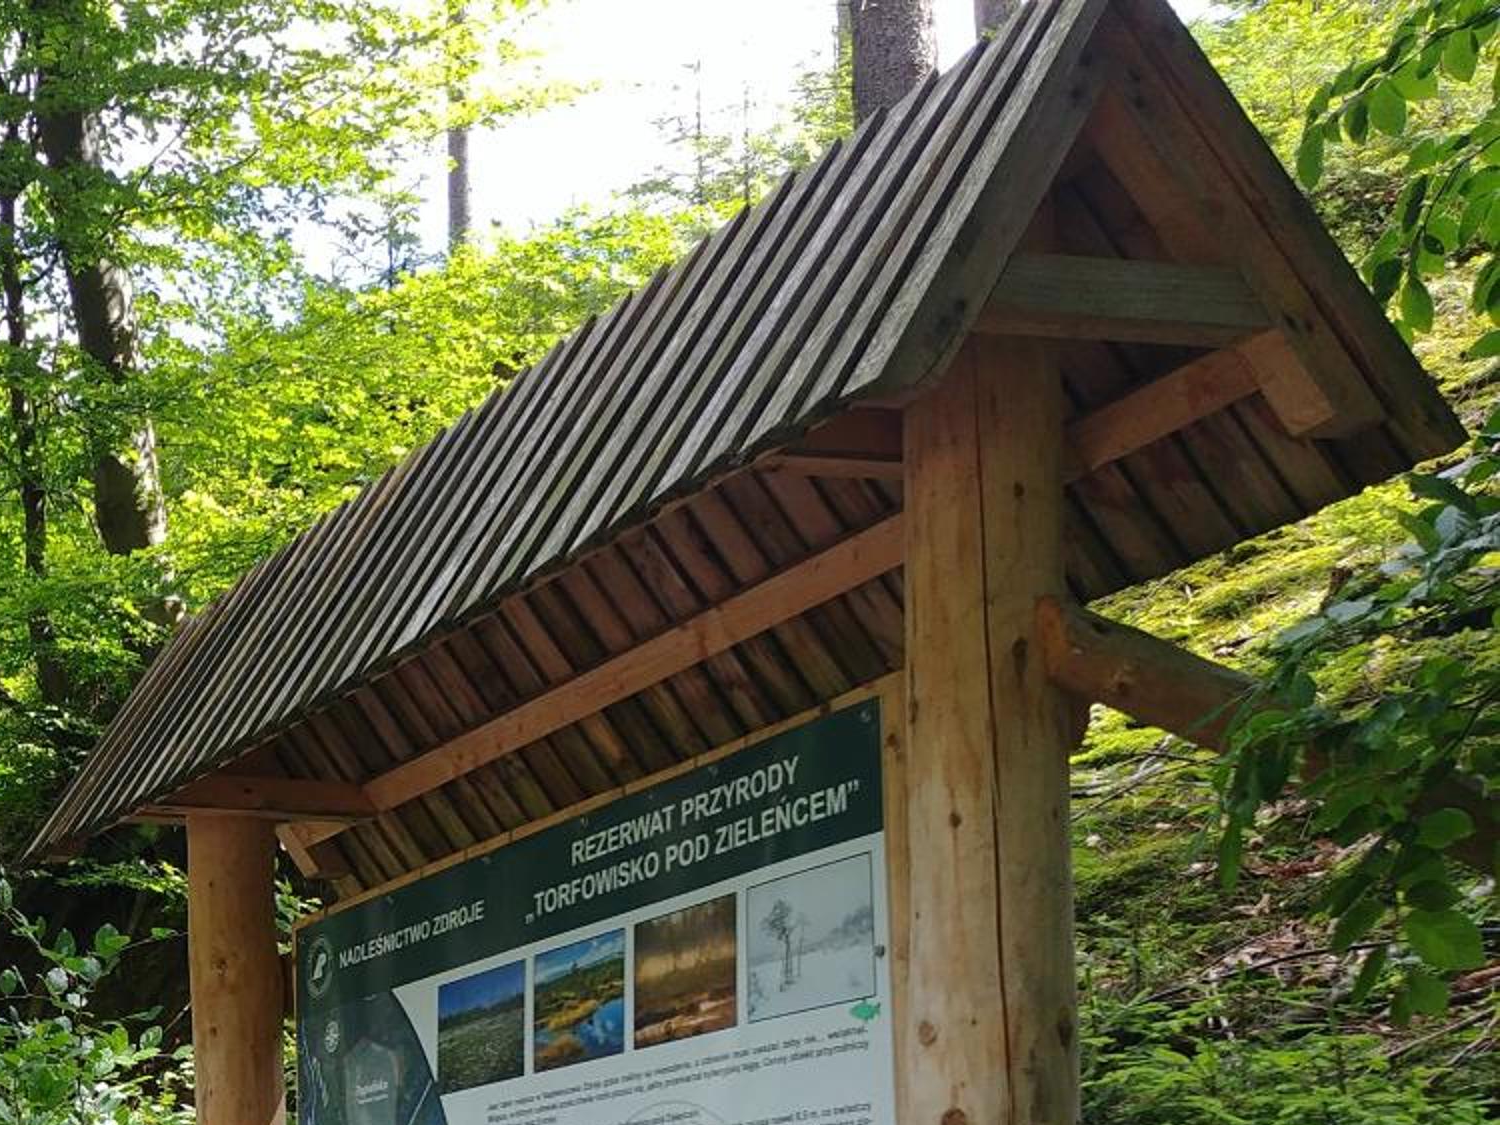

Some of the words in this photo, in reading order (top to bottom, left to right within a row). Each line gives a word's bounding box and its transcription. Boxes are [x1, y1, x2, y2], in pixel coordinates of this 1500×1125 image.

[526, 852, 659, 924] „TORFOWISKO
[666, 834, 709, 870] POD
[715, 780, 858, 854] ZIELEŃCEM”
[572, 804, 675, 865] REZERWAT
[681, 756, 798, 826] PRZYRODY
[340, 921, 430, 968] NADLEŚNICTWO
[432, 900, 484, 935] ZDROJE
